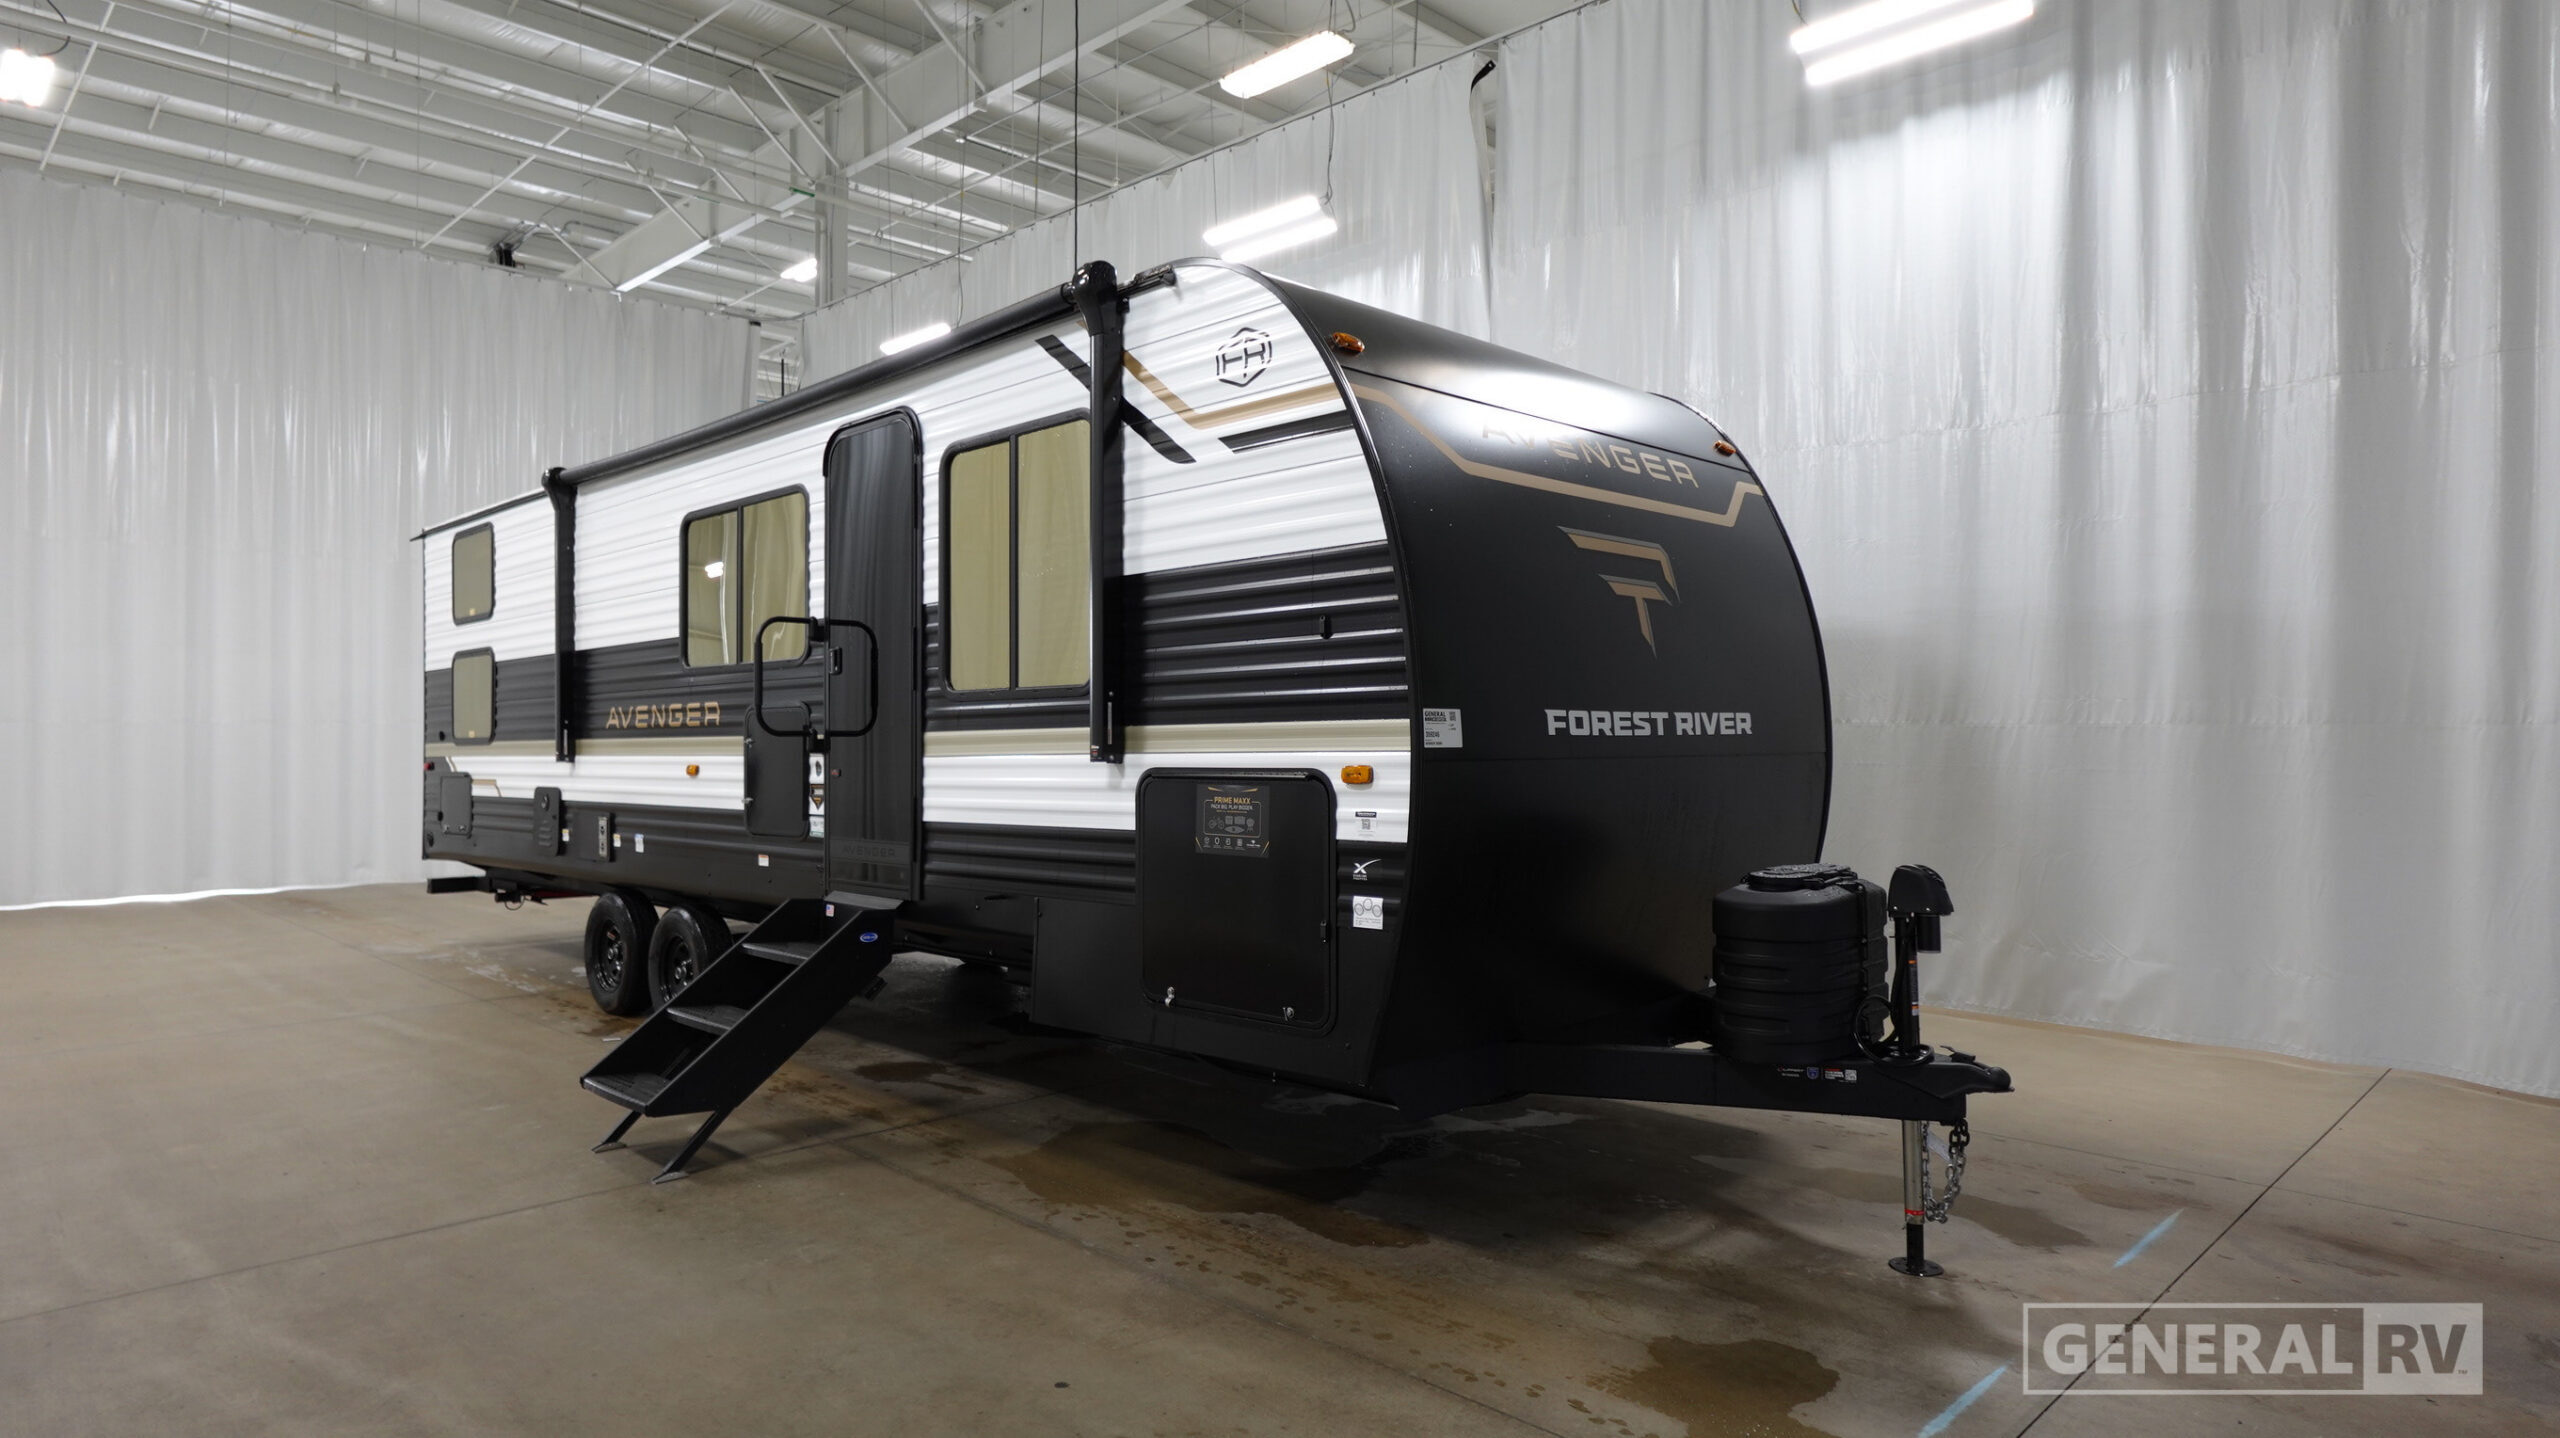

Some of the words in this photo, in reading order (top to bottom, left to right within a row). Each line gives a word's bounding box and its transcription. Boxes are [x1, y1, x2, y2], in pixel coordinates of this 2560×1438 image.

[605, 701, 720, 729] AVENGER
[1544, 709, 1669, 736] FOREST
[1673, 712, 1753, 736] RIVER
